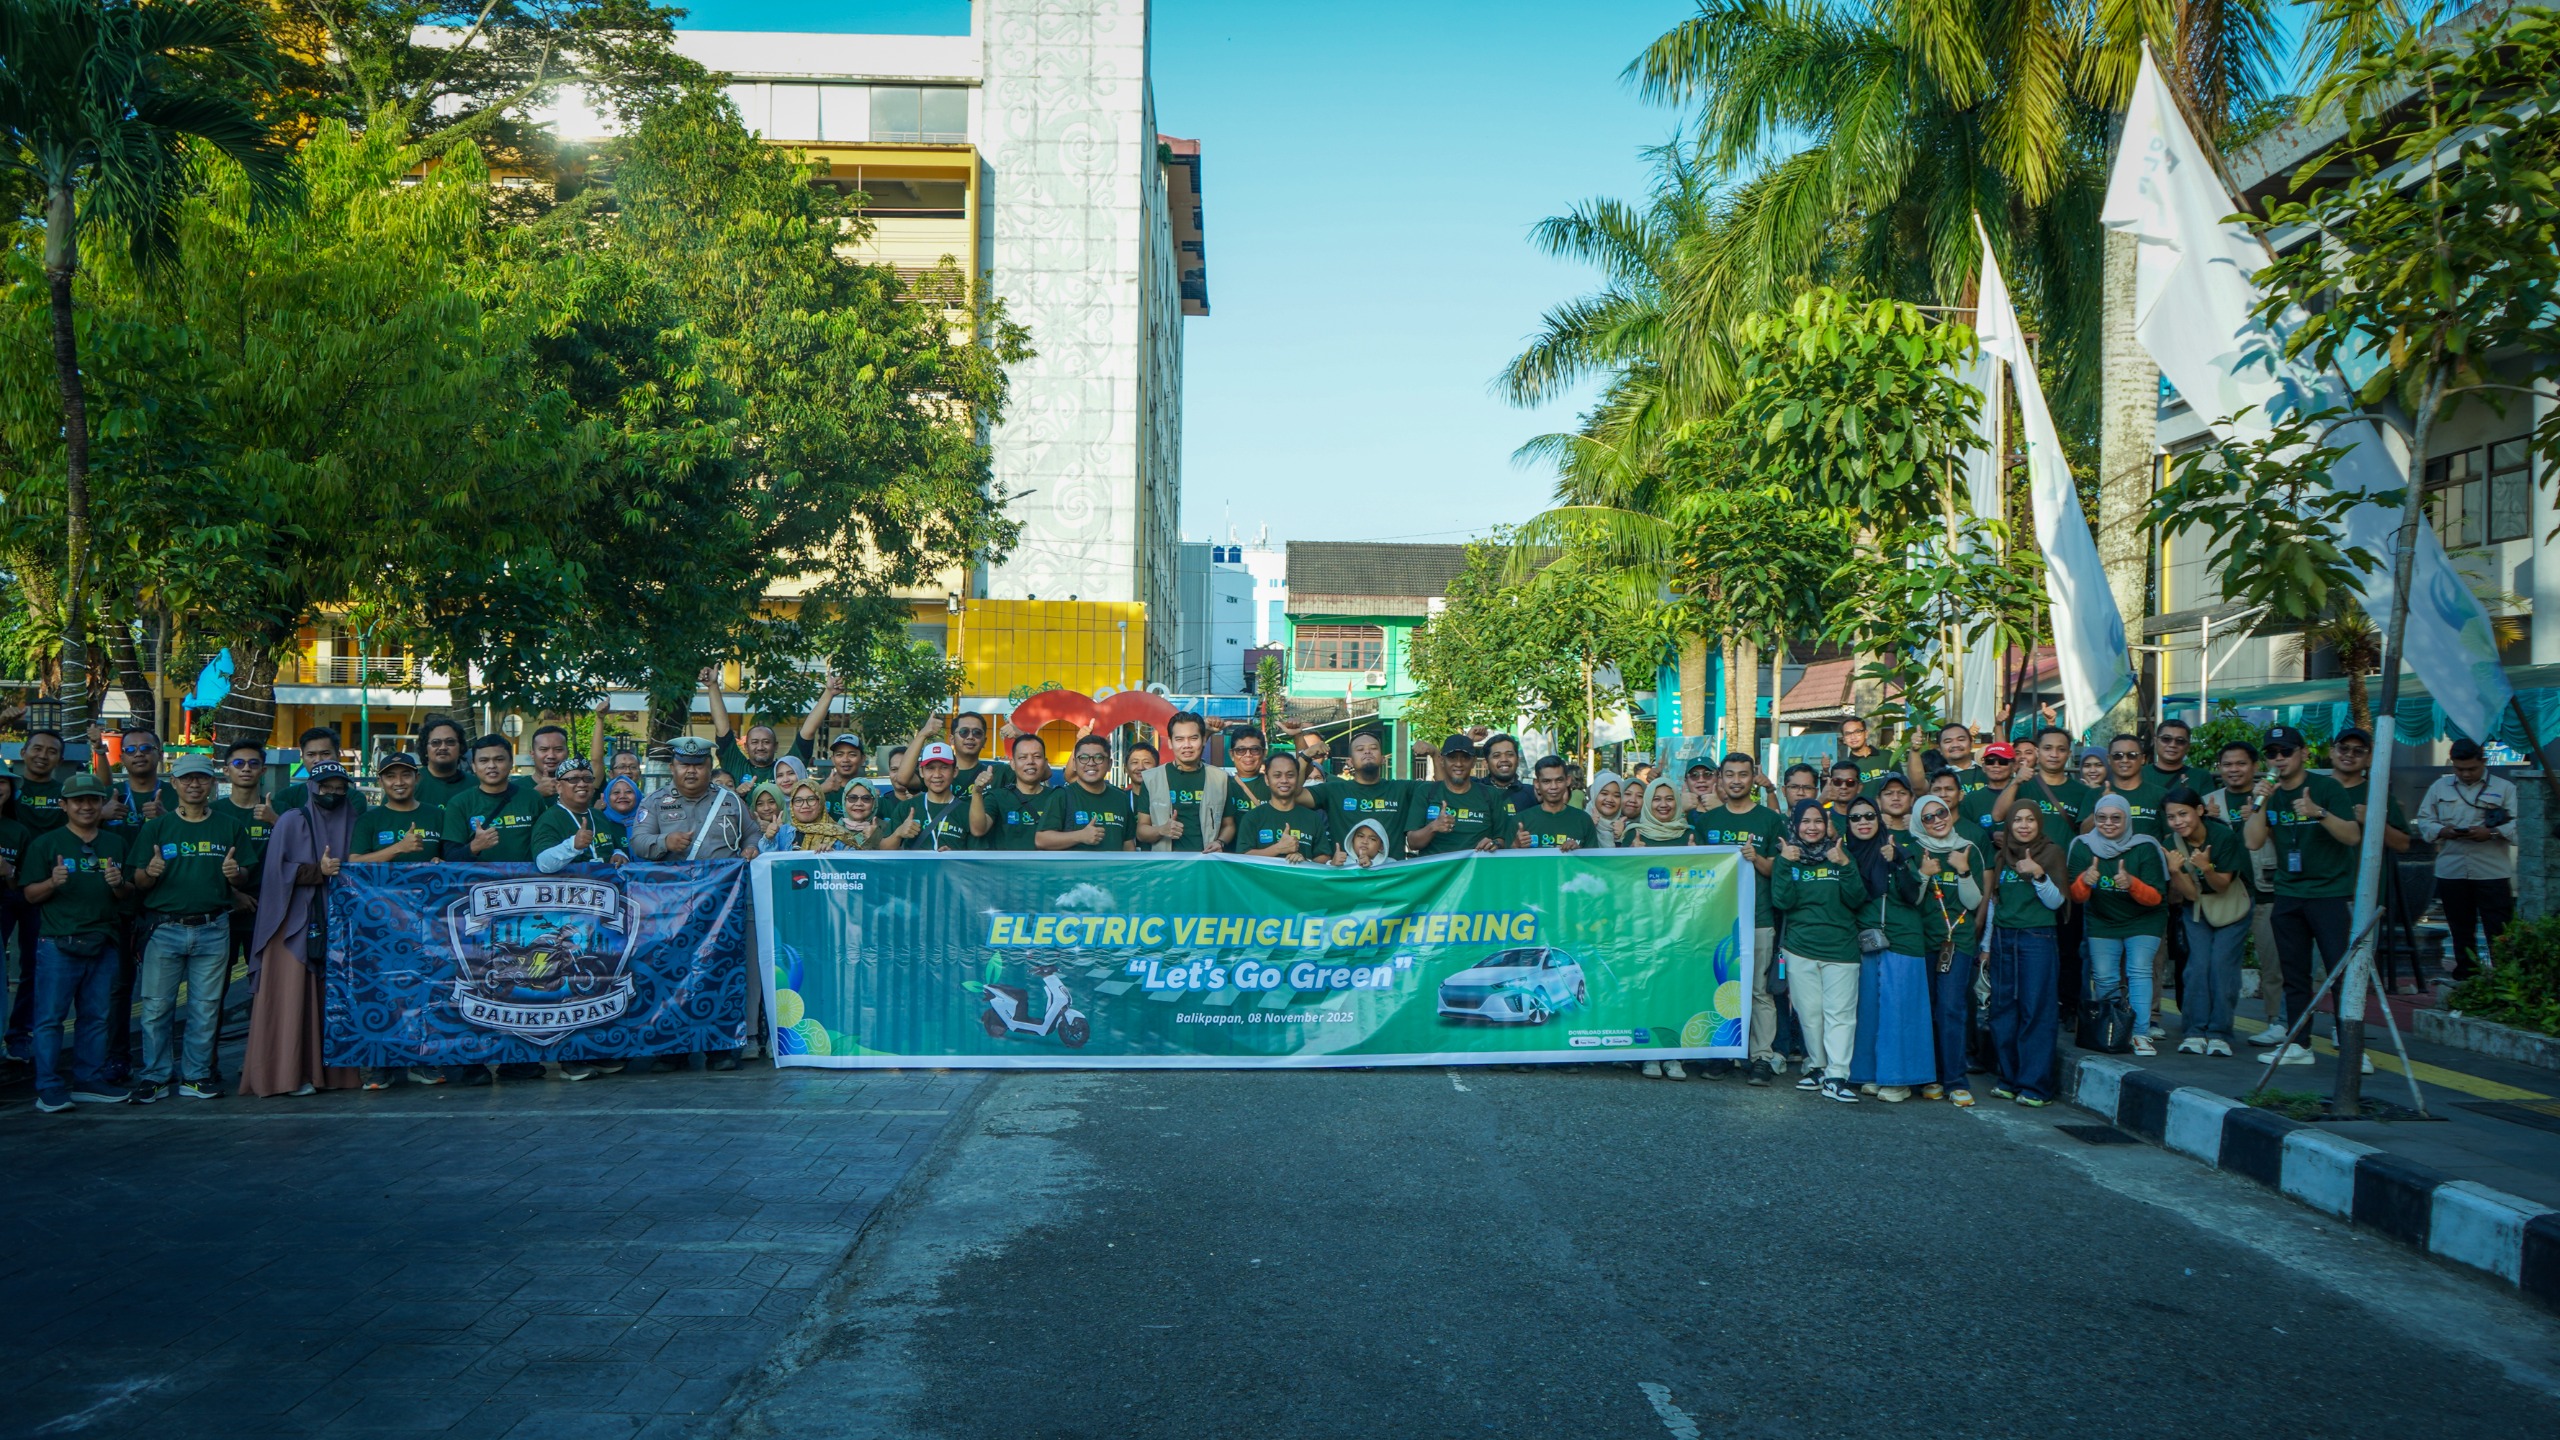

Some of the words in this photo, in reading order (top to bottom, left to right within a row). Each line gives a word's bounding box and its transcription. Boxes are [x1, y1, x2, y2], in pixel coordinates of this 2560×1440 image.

[948, 824, 963, 834] PLN
[813, 870, 867, 880] Danantara
[1689, 869, 1715, 878] PLN
[813, 881, 864, 890] Indonesia
[483, 886, 524, 910] EV
[534, 884, 607, 910] BIKE
[988, 914, 1166, 946] ELECTRIC
[1172, 915, 1324, 947] VEHICLE
[1330, 911, 1538, 946] GATHERING
[1233, 960, 1282, 990] Go
[470, 1000, 618, 1026] BALIKPAPAN
[1175, 1012, 1245, 1026] Balikpapan,
[1247, 1012, 1263, 1024] 08
[1264, 1012, 1325, 1024] November
[1327, 1011, 1355, 1023] 2025
